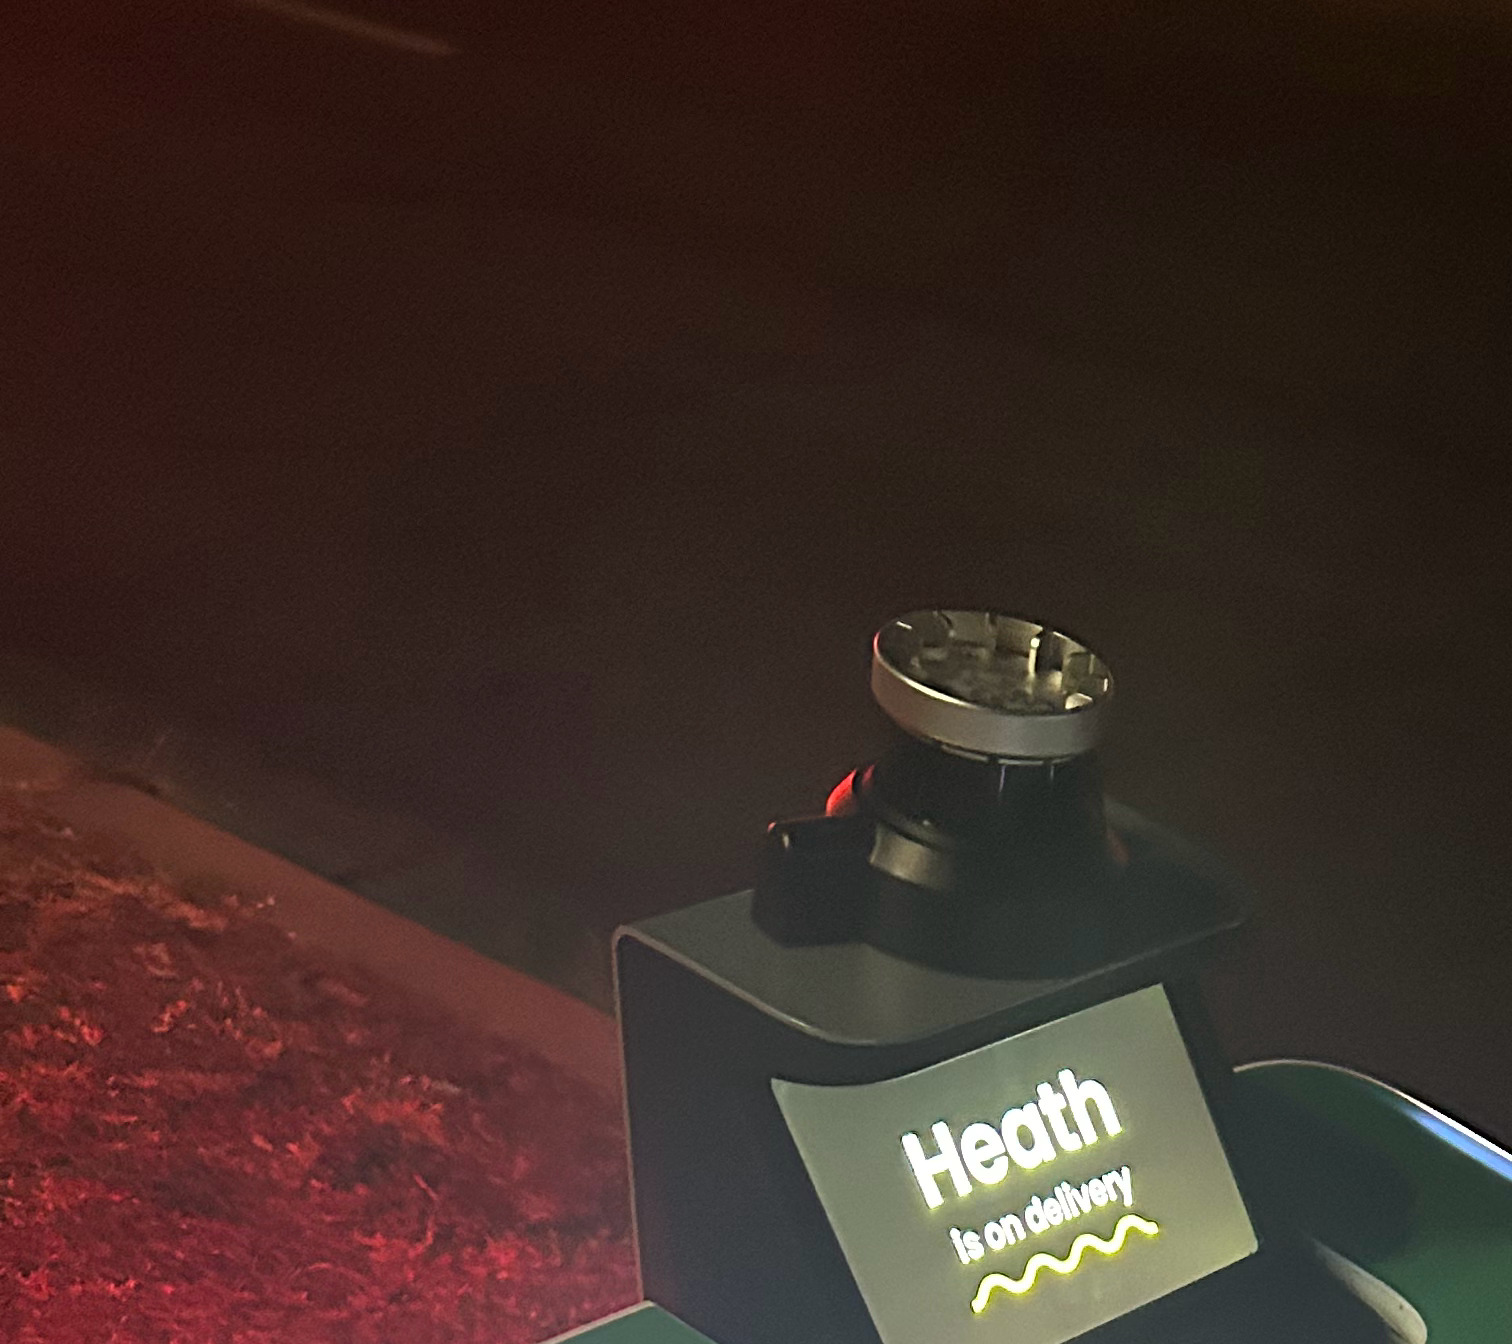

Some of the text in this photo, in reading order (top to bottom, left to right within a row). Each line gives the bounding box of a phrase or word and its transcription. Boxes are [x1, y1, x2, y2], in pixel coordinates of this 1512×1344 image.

[901, 1068, 1124, 1209] Heath
[949, 1166, 1134, 1265] is on delivery
